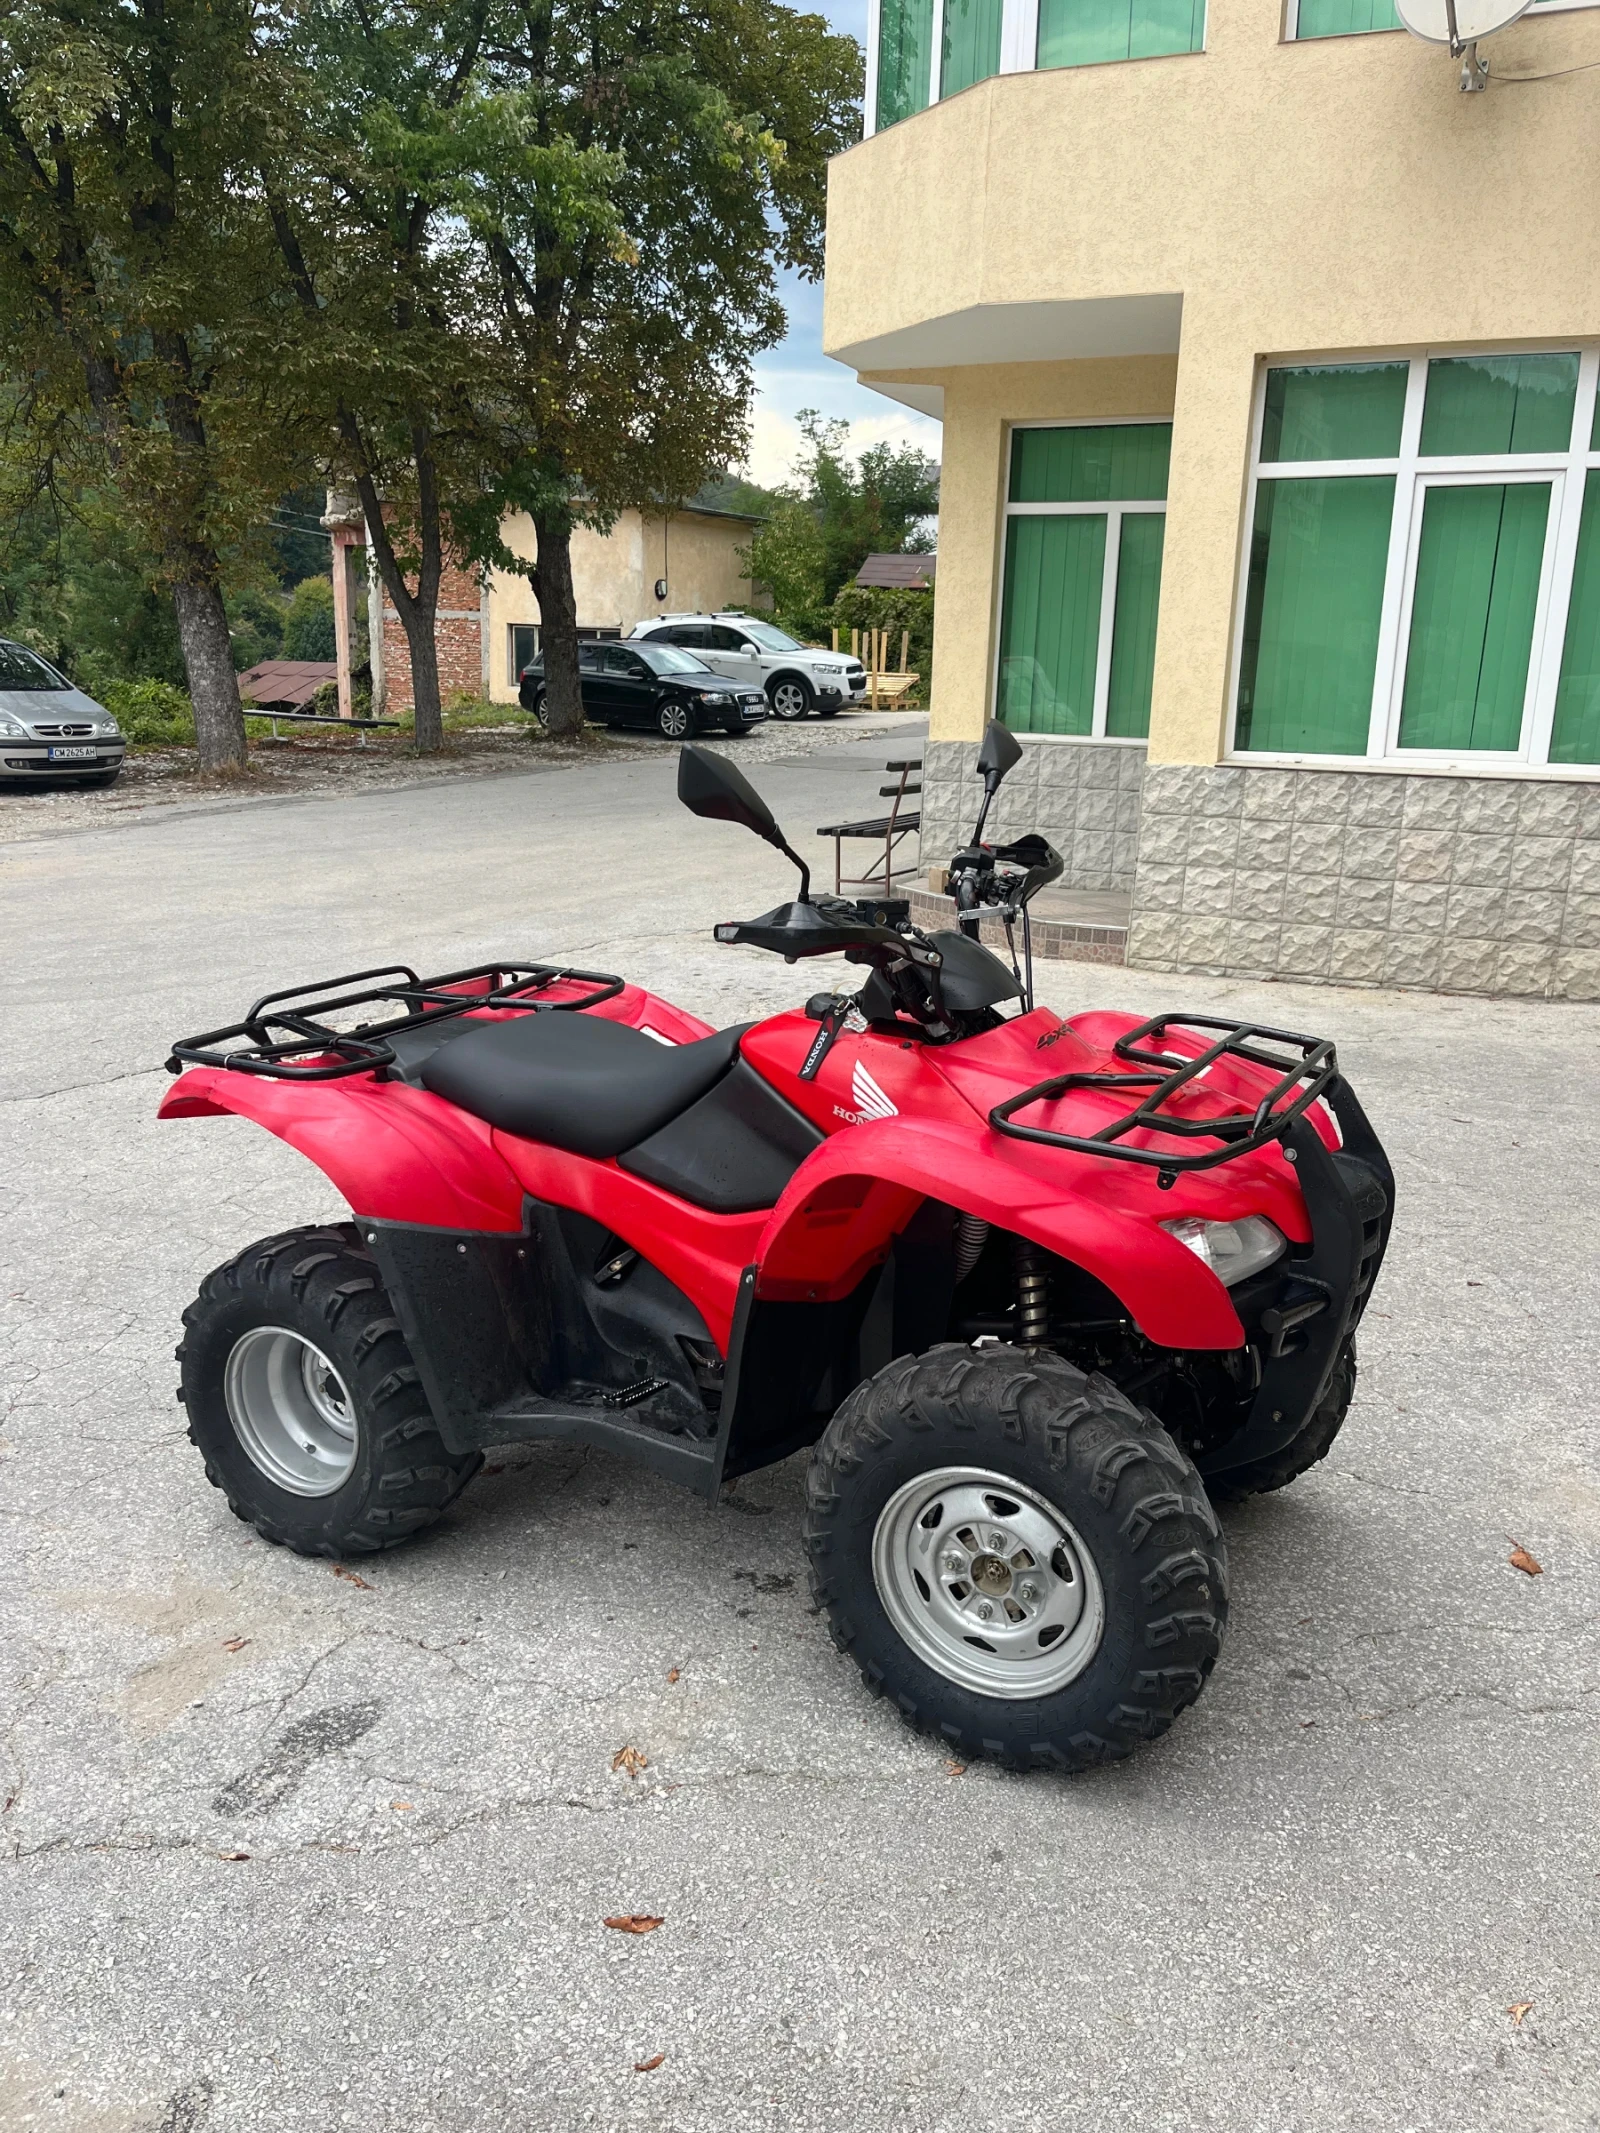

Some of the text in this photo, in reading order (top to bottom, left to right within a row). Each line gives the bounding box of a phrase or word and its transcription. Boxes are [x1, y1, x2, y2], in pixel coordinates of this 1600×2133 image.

[66, 748, 85, 757] 2625
[801, 1030, 829, 1076] HONDA
[832, 1104, 870, 1126] HON
